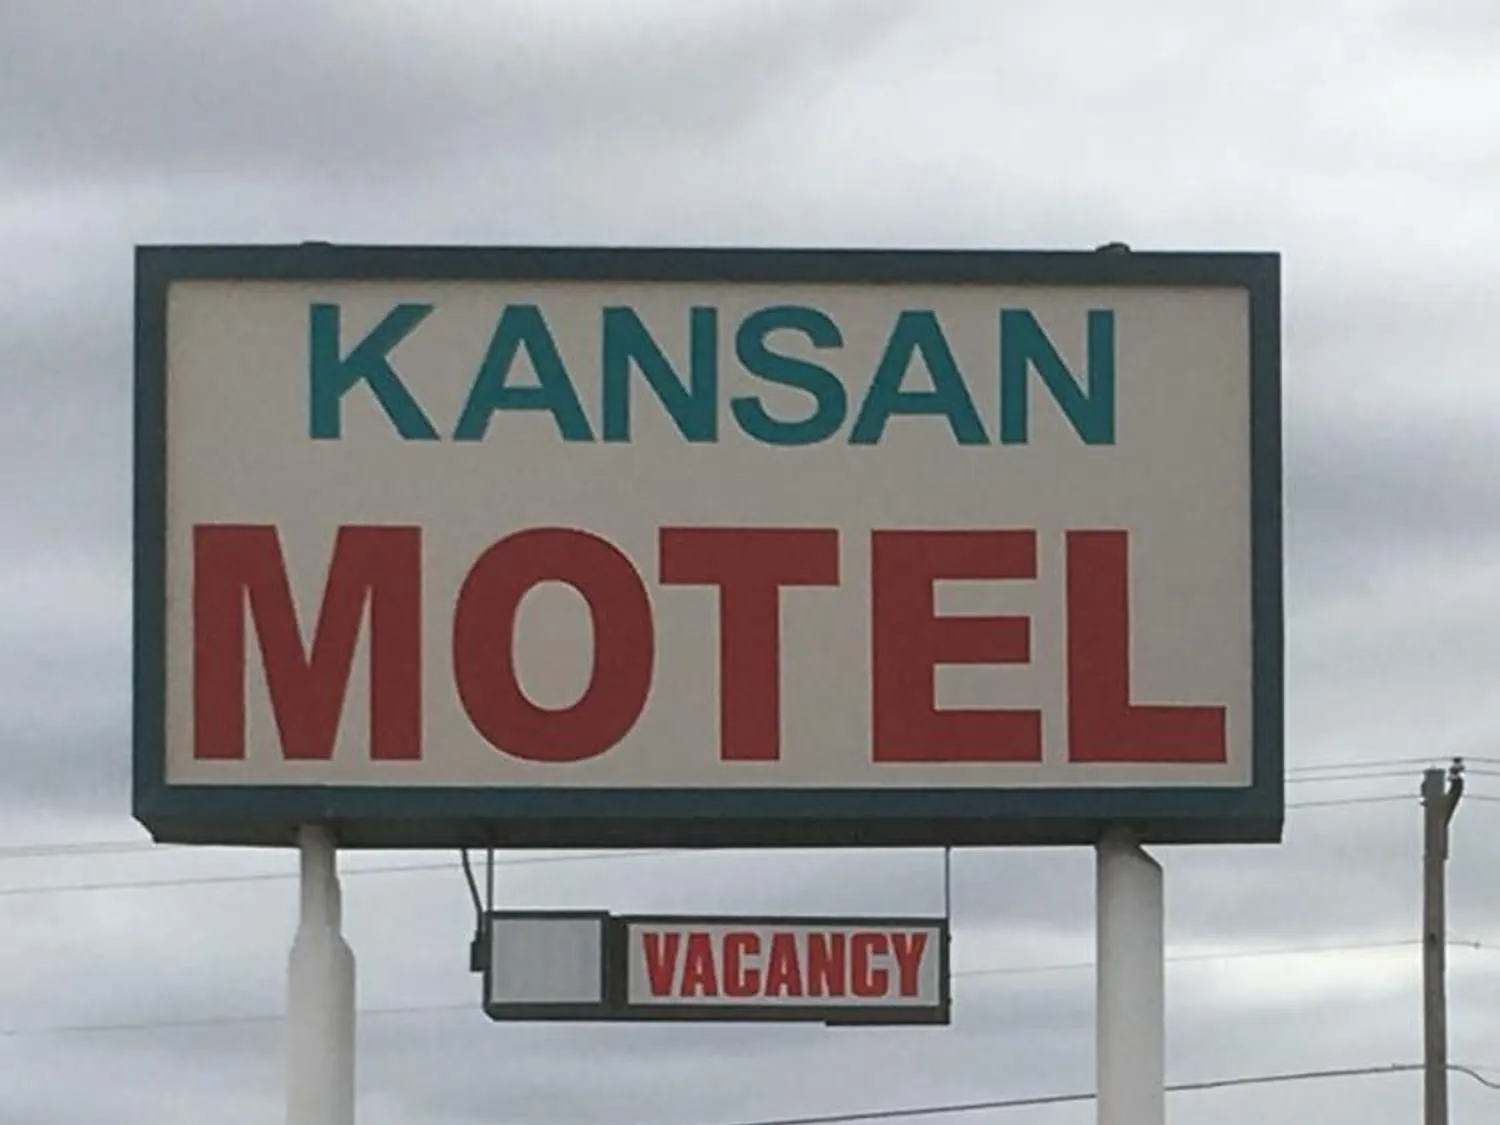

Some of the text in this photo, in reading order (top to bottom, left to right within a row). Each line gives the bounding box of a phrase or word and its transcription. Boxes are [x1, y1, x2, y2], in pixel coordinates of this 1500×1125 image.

[309, 301, 1116, 447] KANSAN
[192, 524, 1227, 764] MOTEL
[641, 932, 929, 998] VACANCY
